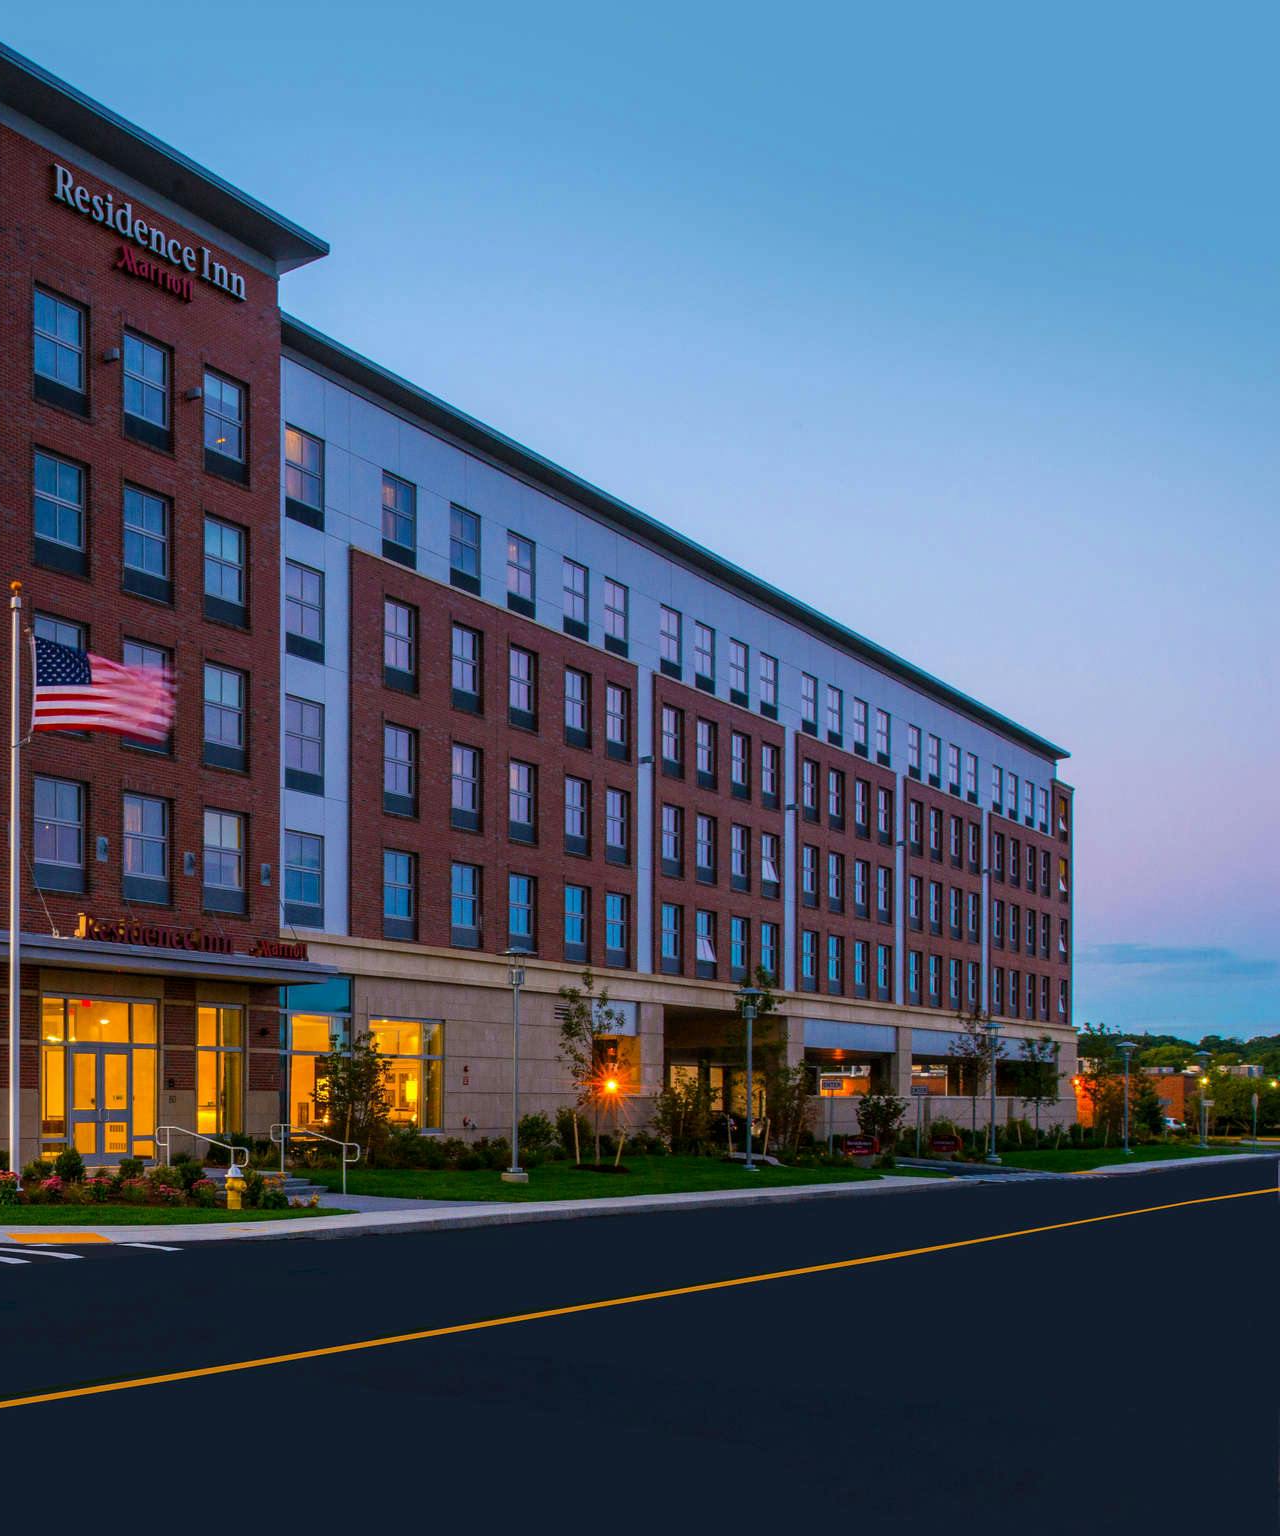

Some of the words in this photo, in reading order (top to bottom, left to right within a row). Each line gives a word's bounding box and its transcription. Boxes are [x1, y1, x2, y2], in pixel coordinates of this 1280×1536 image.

[54, 163, 196, 272] Residence
[201, 246, 247, 301] Inn
[116, 245, 194, 300] Marriott
